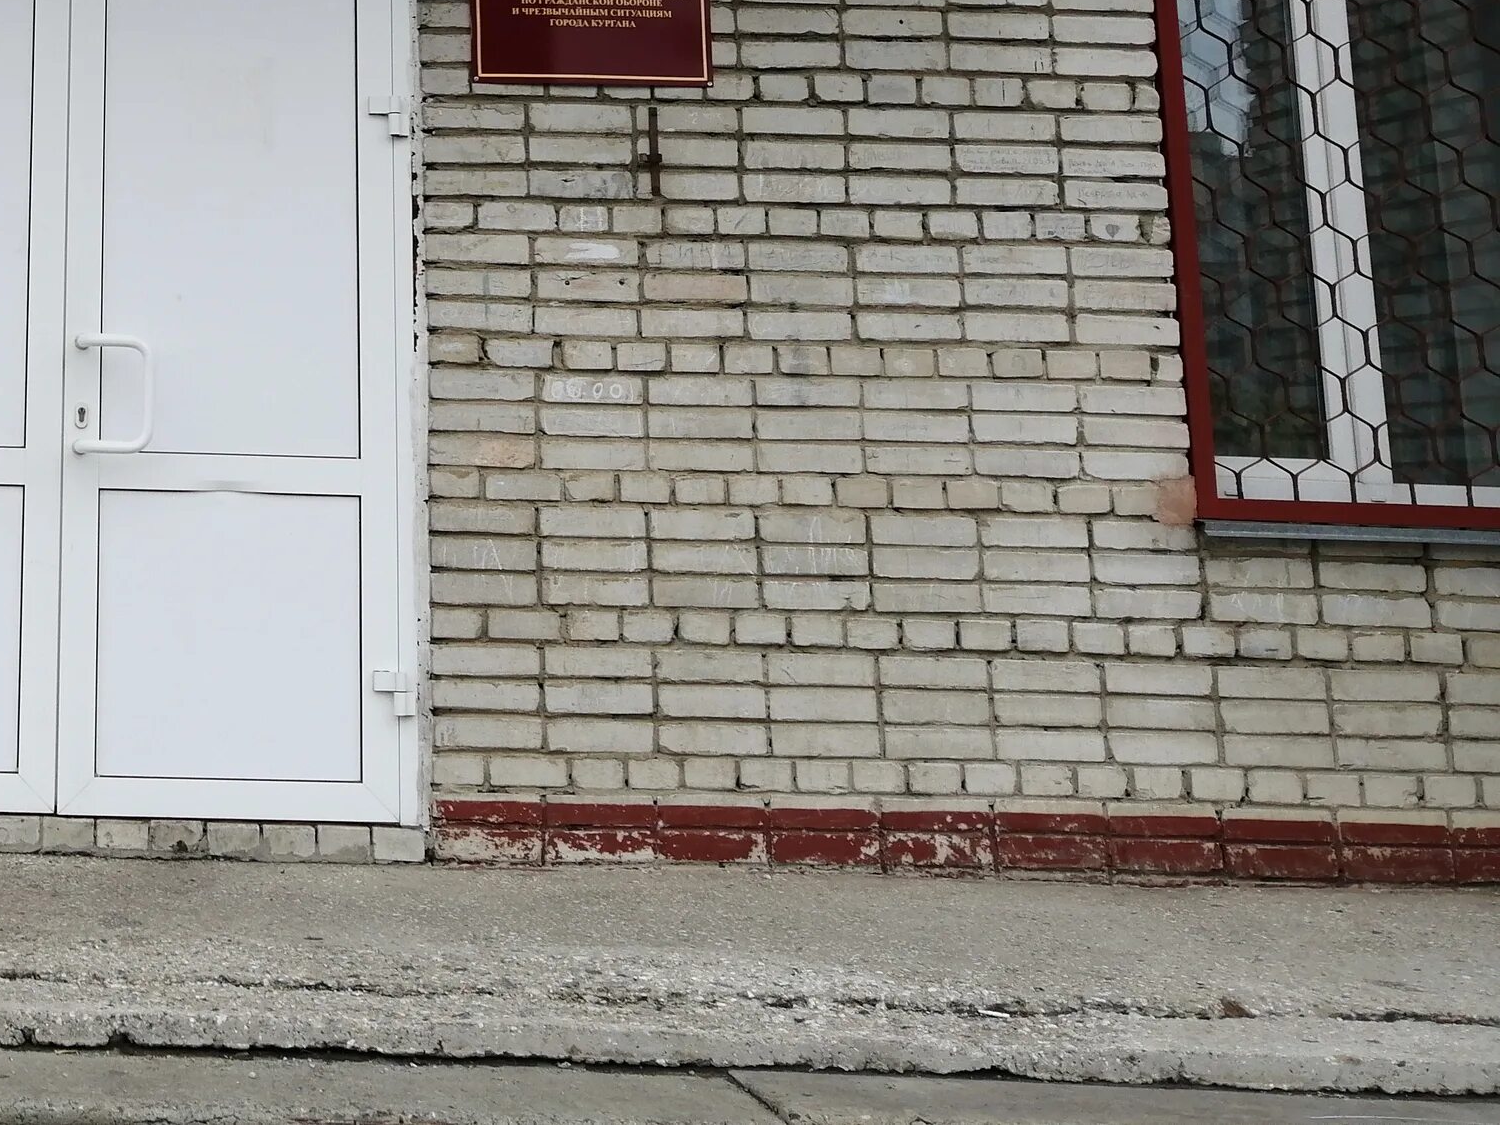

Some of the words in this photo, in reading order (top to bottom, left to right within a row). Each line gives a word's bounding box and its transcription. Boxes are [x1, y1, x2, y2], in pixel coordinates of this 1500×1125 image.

[512, 7, 520, 15] И
[521, 6, 608, 17] ЧРЕЗВЫЧАЙНЫМ
[610, 8, 672, 18] СИТУАЦИЯМ
[549, 18, 590, 28] ГОРОДА
[591, 19, 636, 28] КУРГАНА
